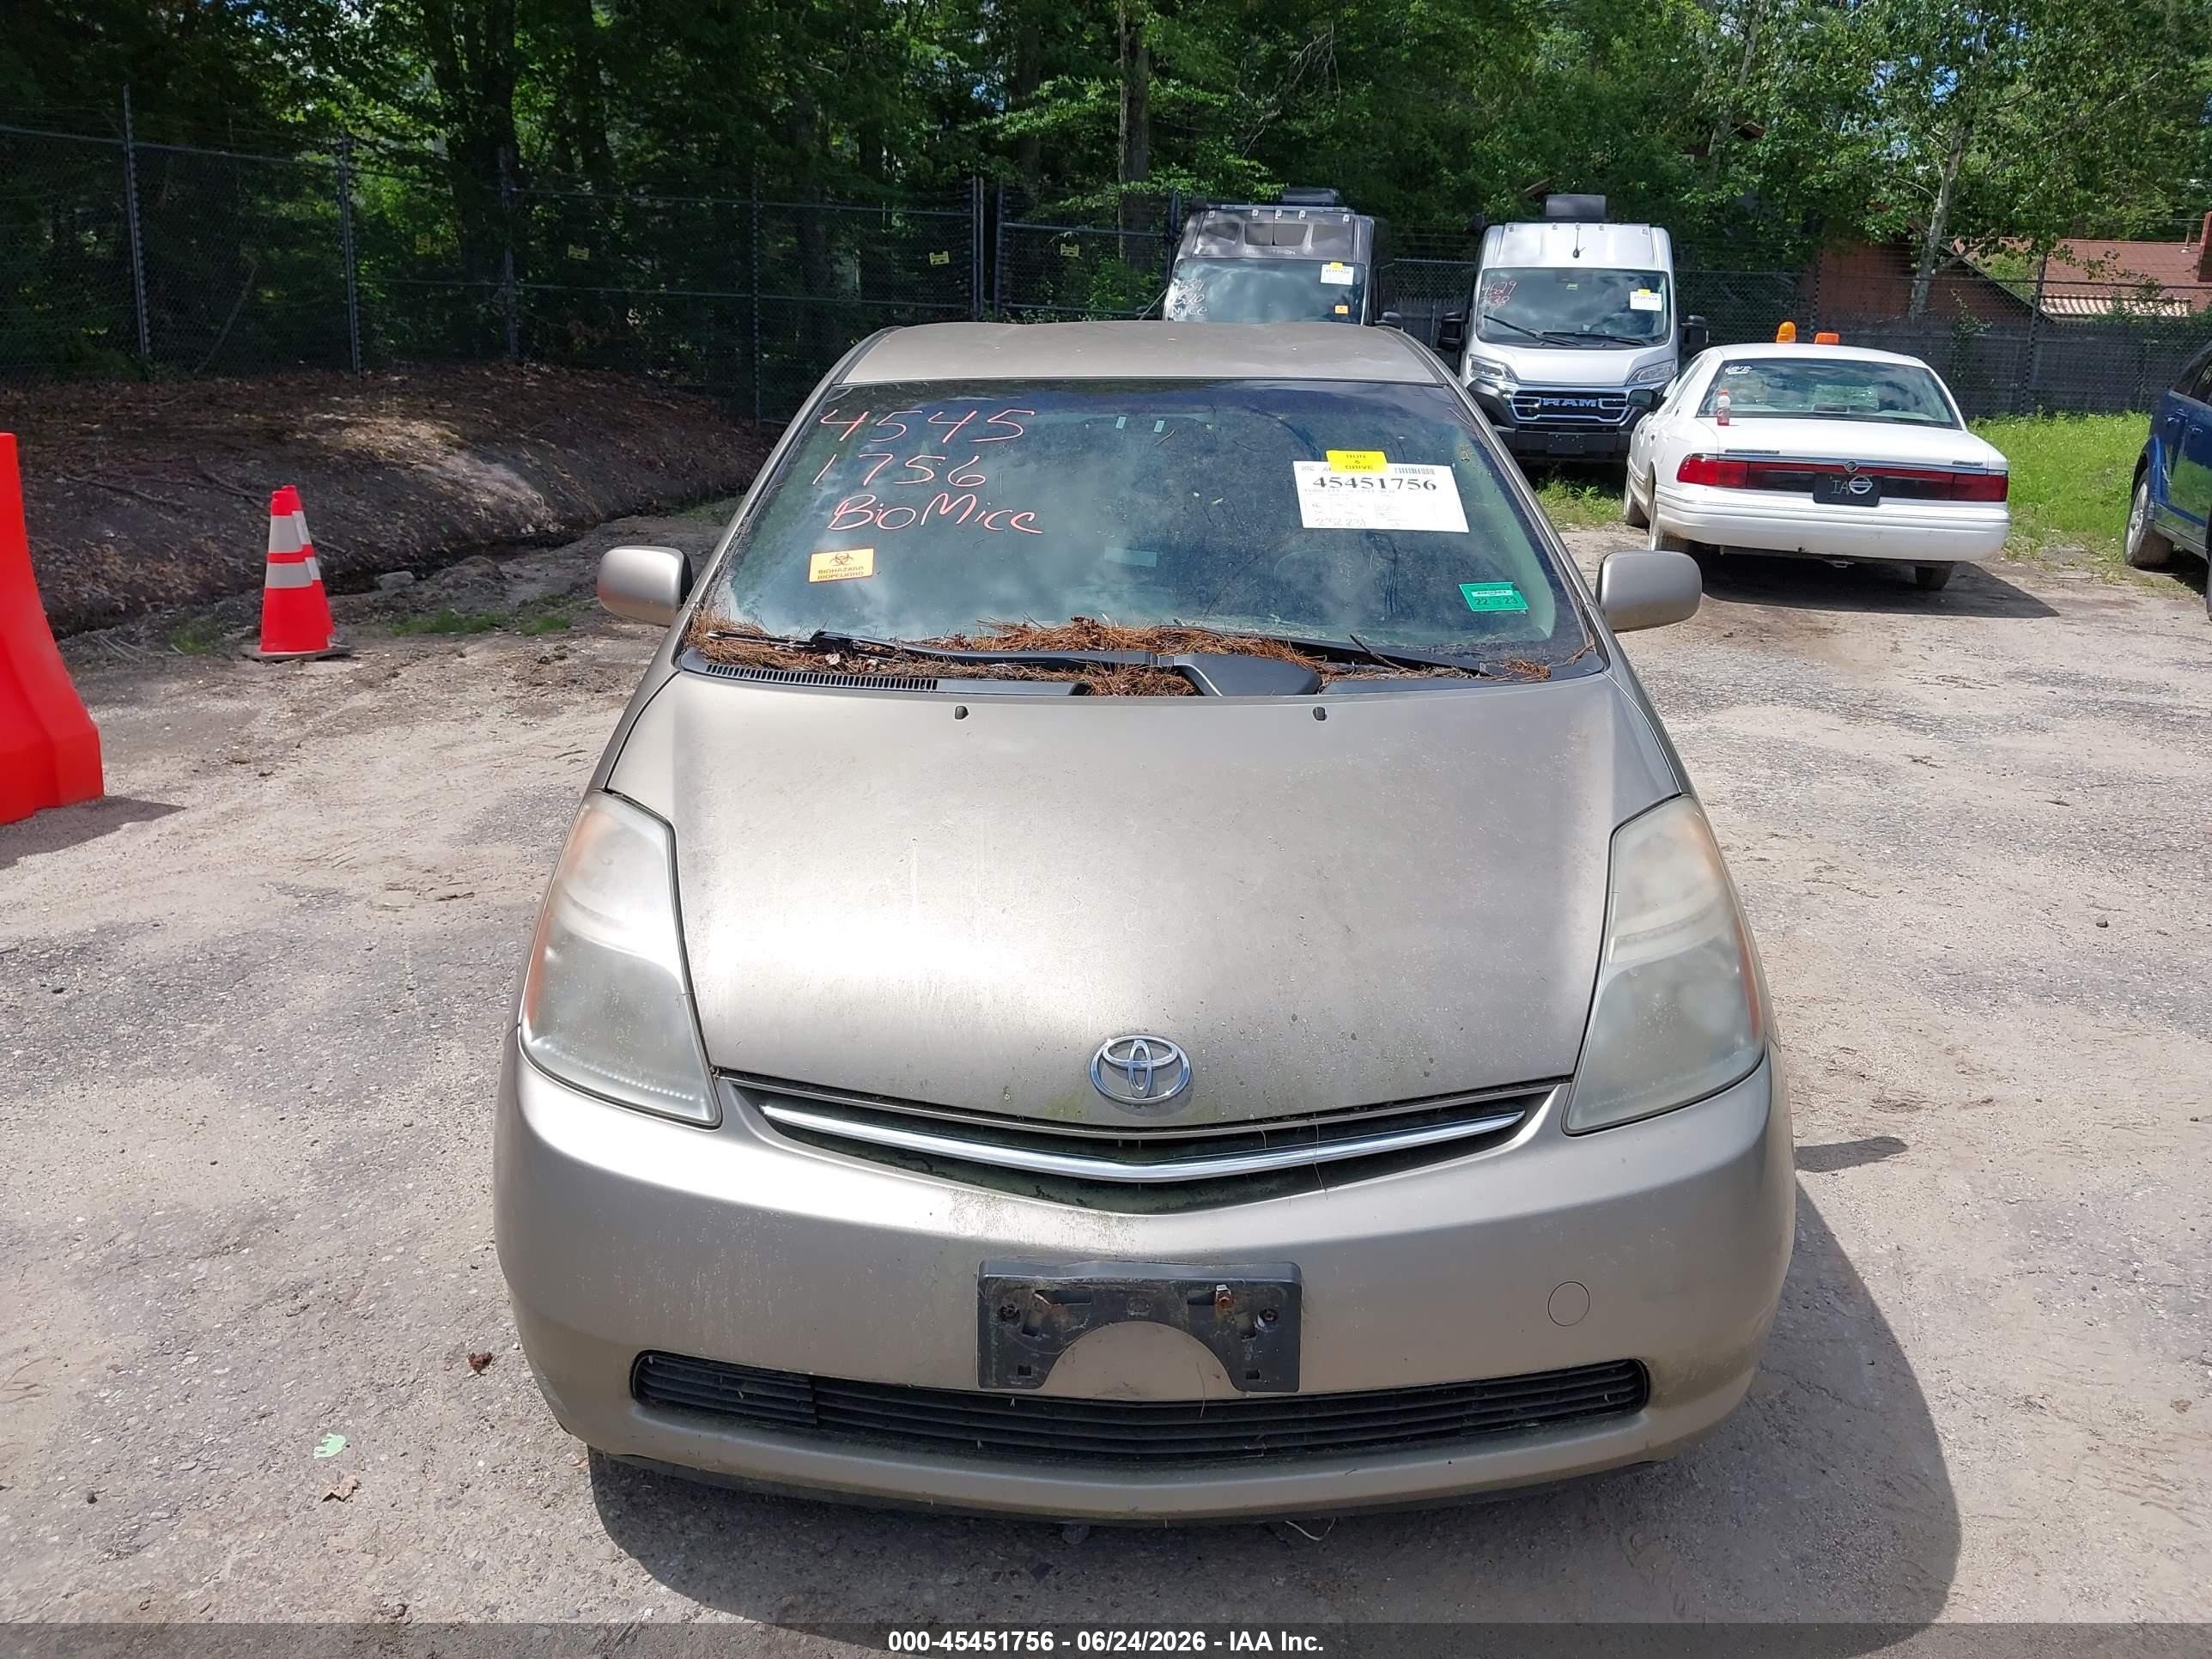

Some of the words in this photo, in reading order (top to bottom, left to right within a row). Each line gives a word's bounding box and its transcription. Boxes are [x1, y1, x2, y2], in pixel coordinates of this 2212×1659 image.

[1543, 398, 1597, 407] RAM
[820, 409, 1036, 444] 4545
[812, 453, 987, 487] 1756
[1312, 476, 1437, 492] 45451756
